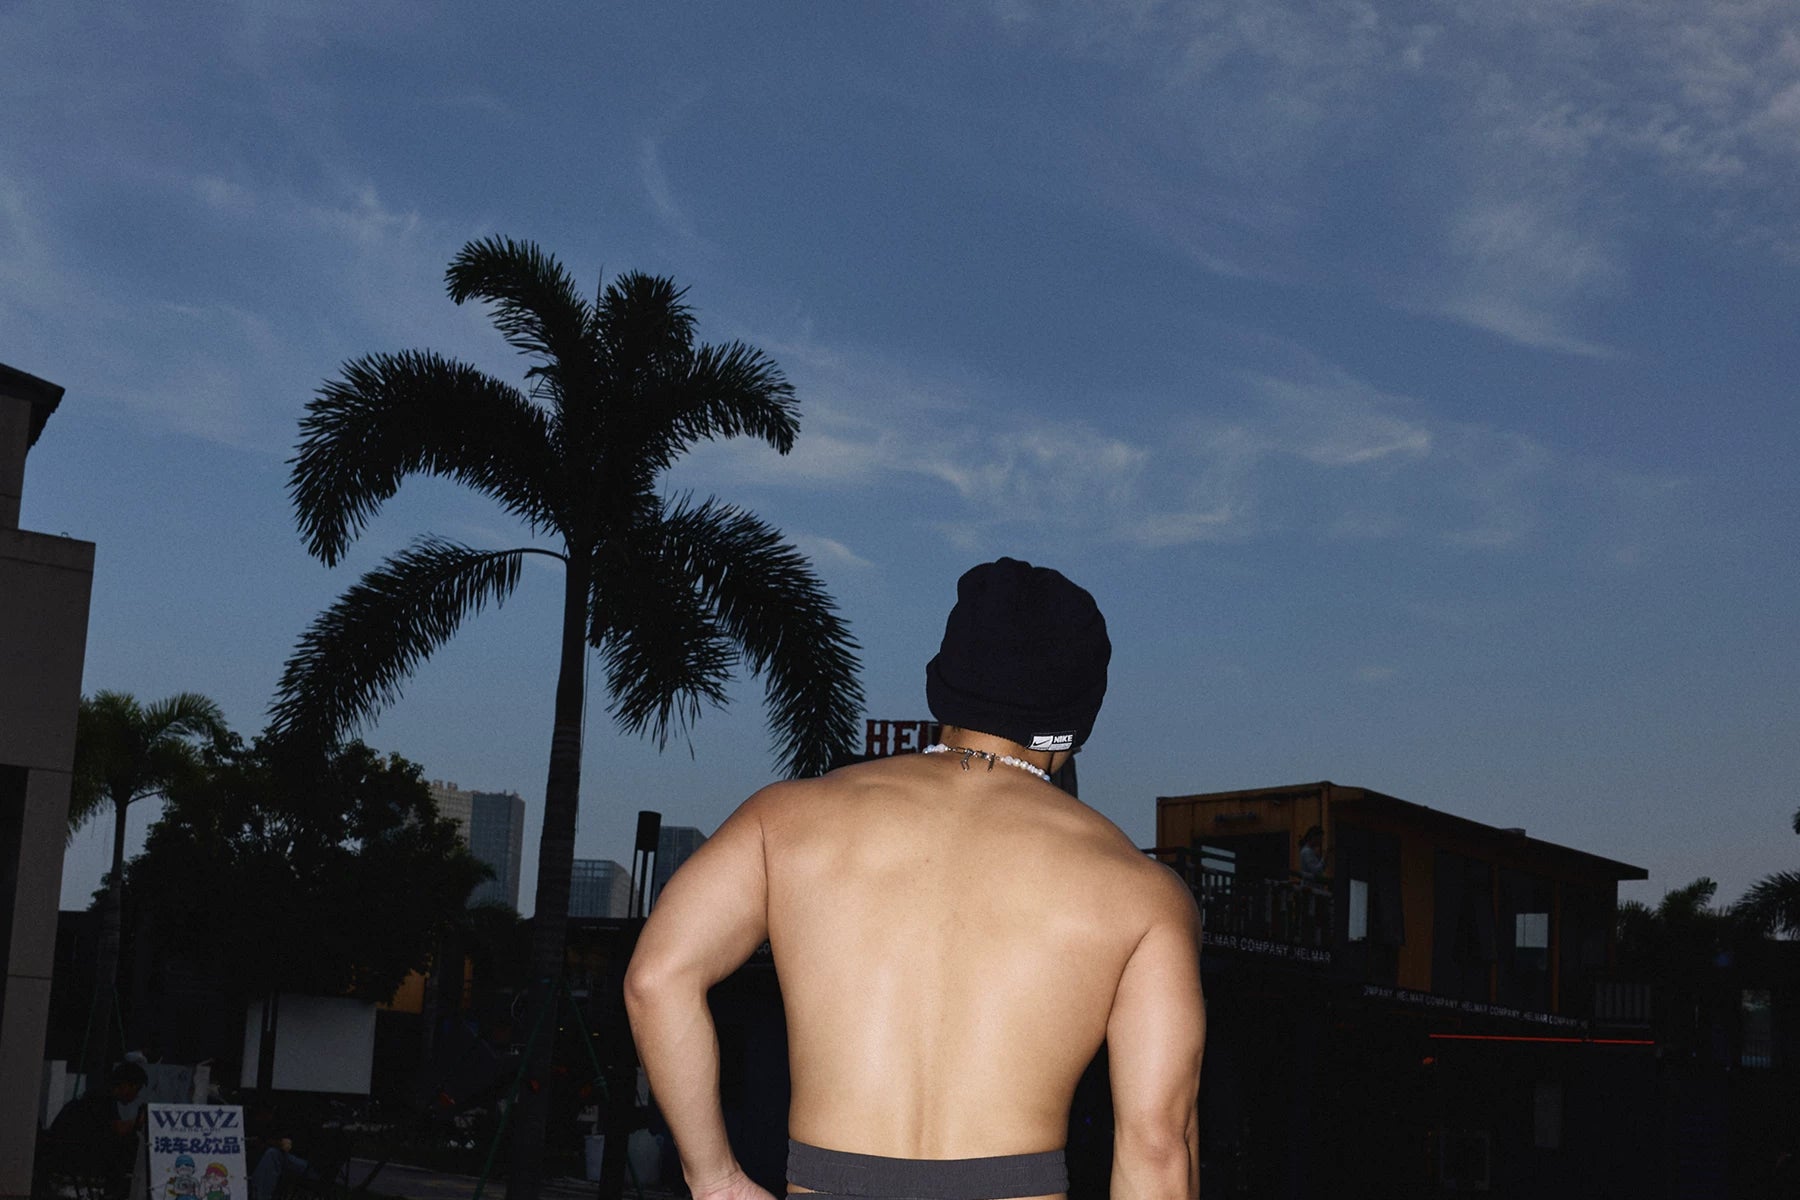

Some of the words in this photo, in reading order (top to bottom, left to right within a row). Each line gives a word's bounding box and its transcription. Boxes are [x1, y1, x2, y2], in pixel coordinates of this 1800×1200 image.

[1053, 734, 1073, 743] NIKE
[1202, 931, 1238, 949] ELMAR
[1240, 937, 1289, 956] COMPANY
